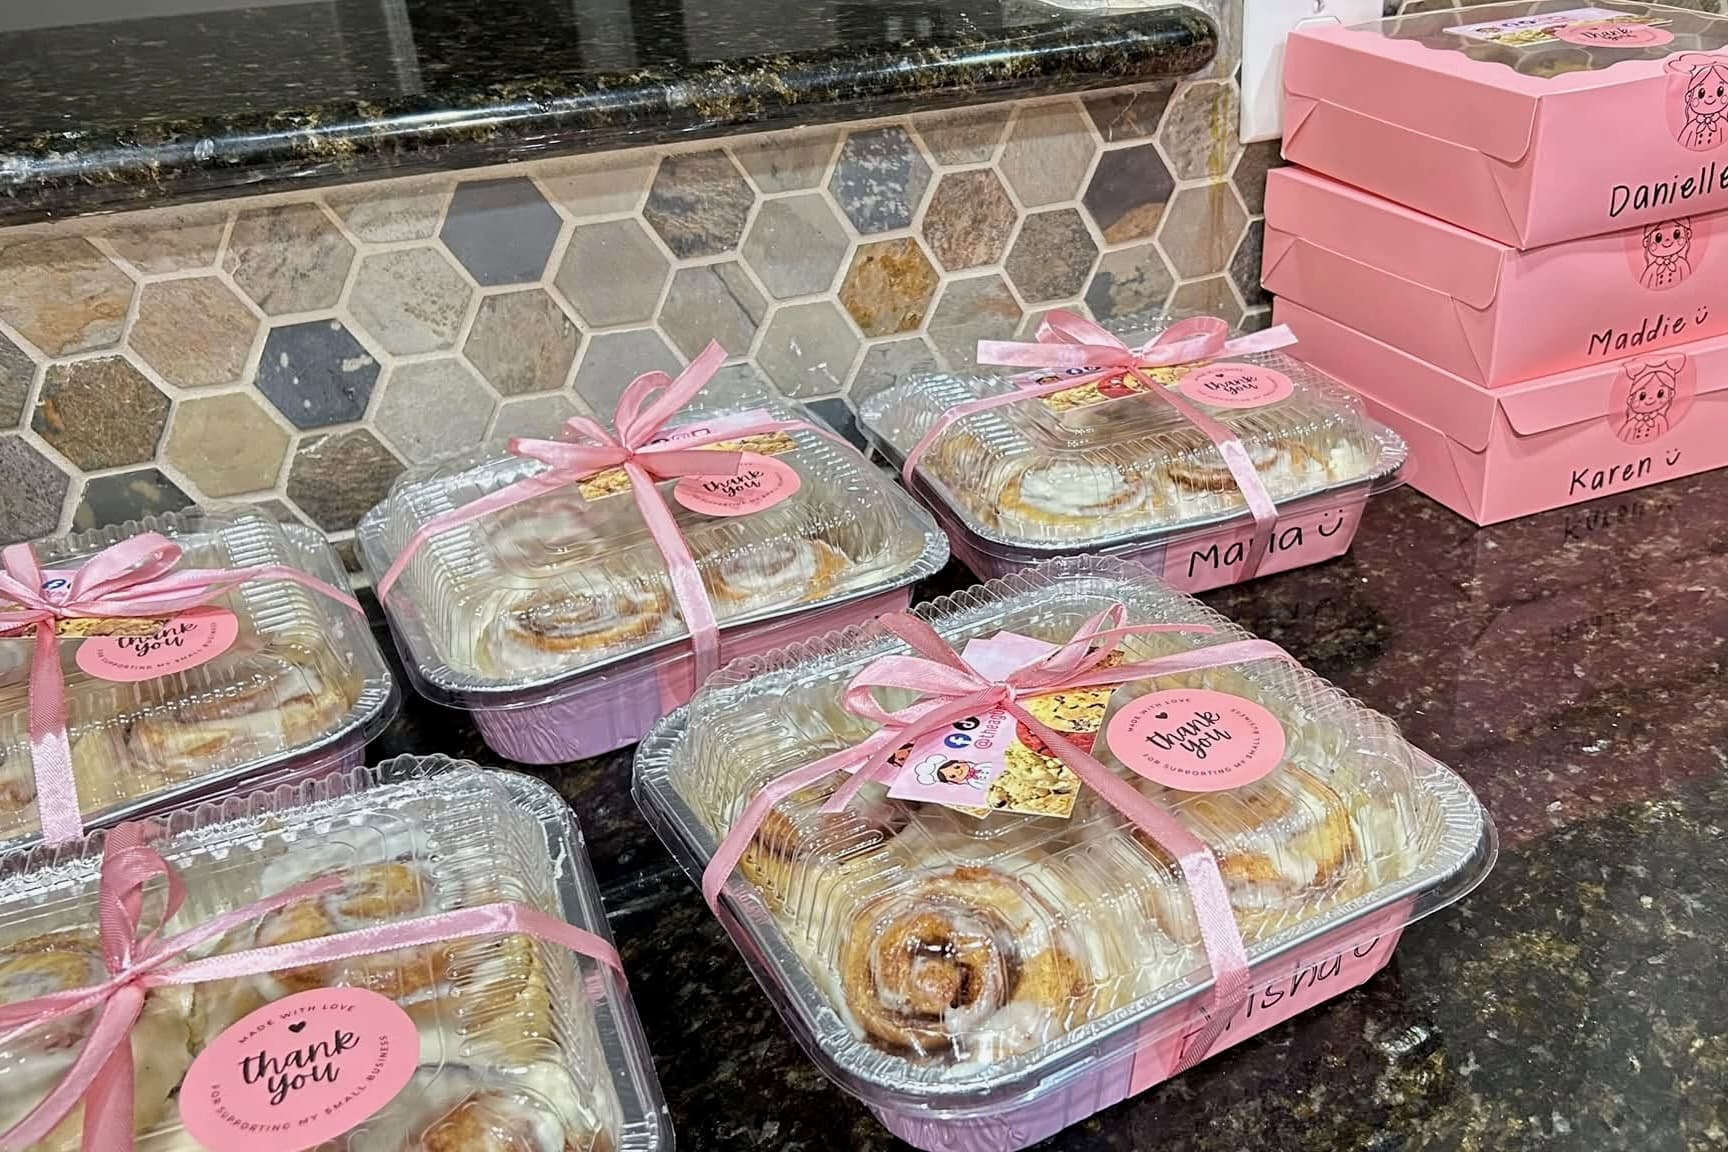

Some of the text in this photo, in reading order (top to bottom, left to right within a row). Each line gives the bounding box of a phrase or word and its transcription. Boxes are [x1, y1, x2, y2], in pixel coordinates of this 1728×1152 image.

[1588, 314, 1686, 356] Maddie
[1204, 375, 1258, 392] thank
[703, 471, 764, 492] thank
[722, 480, 761, 497] you
[1569, 457, 1651, 496] Karen
[1188, 527, 1303, 577] Maia
[135, 637, 184, 657] you
[1128, 716, 1142, 732] MADE
[1142, 702, 1162, 715] WITH
[1145, 711, 1221, 751] thank
[1180, 728, 1232, 760] you
[1142, 753, 1161, 765] FOR
[1163, 764, 1232, 776] SUPPORTING
[1234, 758, 1248, 769] MY
[238, 1004, 356, 1045] MADE WITH LOVE
[237, 1030, 361, 1085] thank
[210, 1035, 390, 1133] FOR SUPPORTING MY SMALL BUSINESS
[267, 1062, 340, 1106] you
